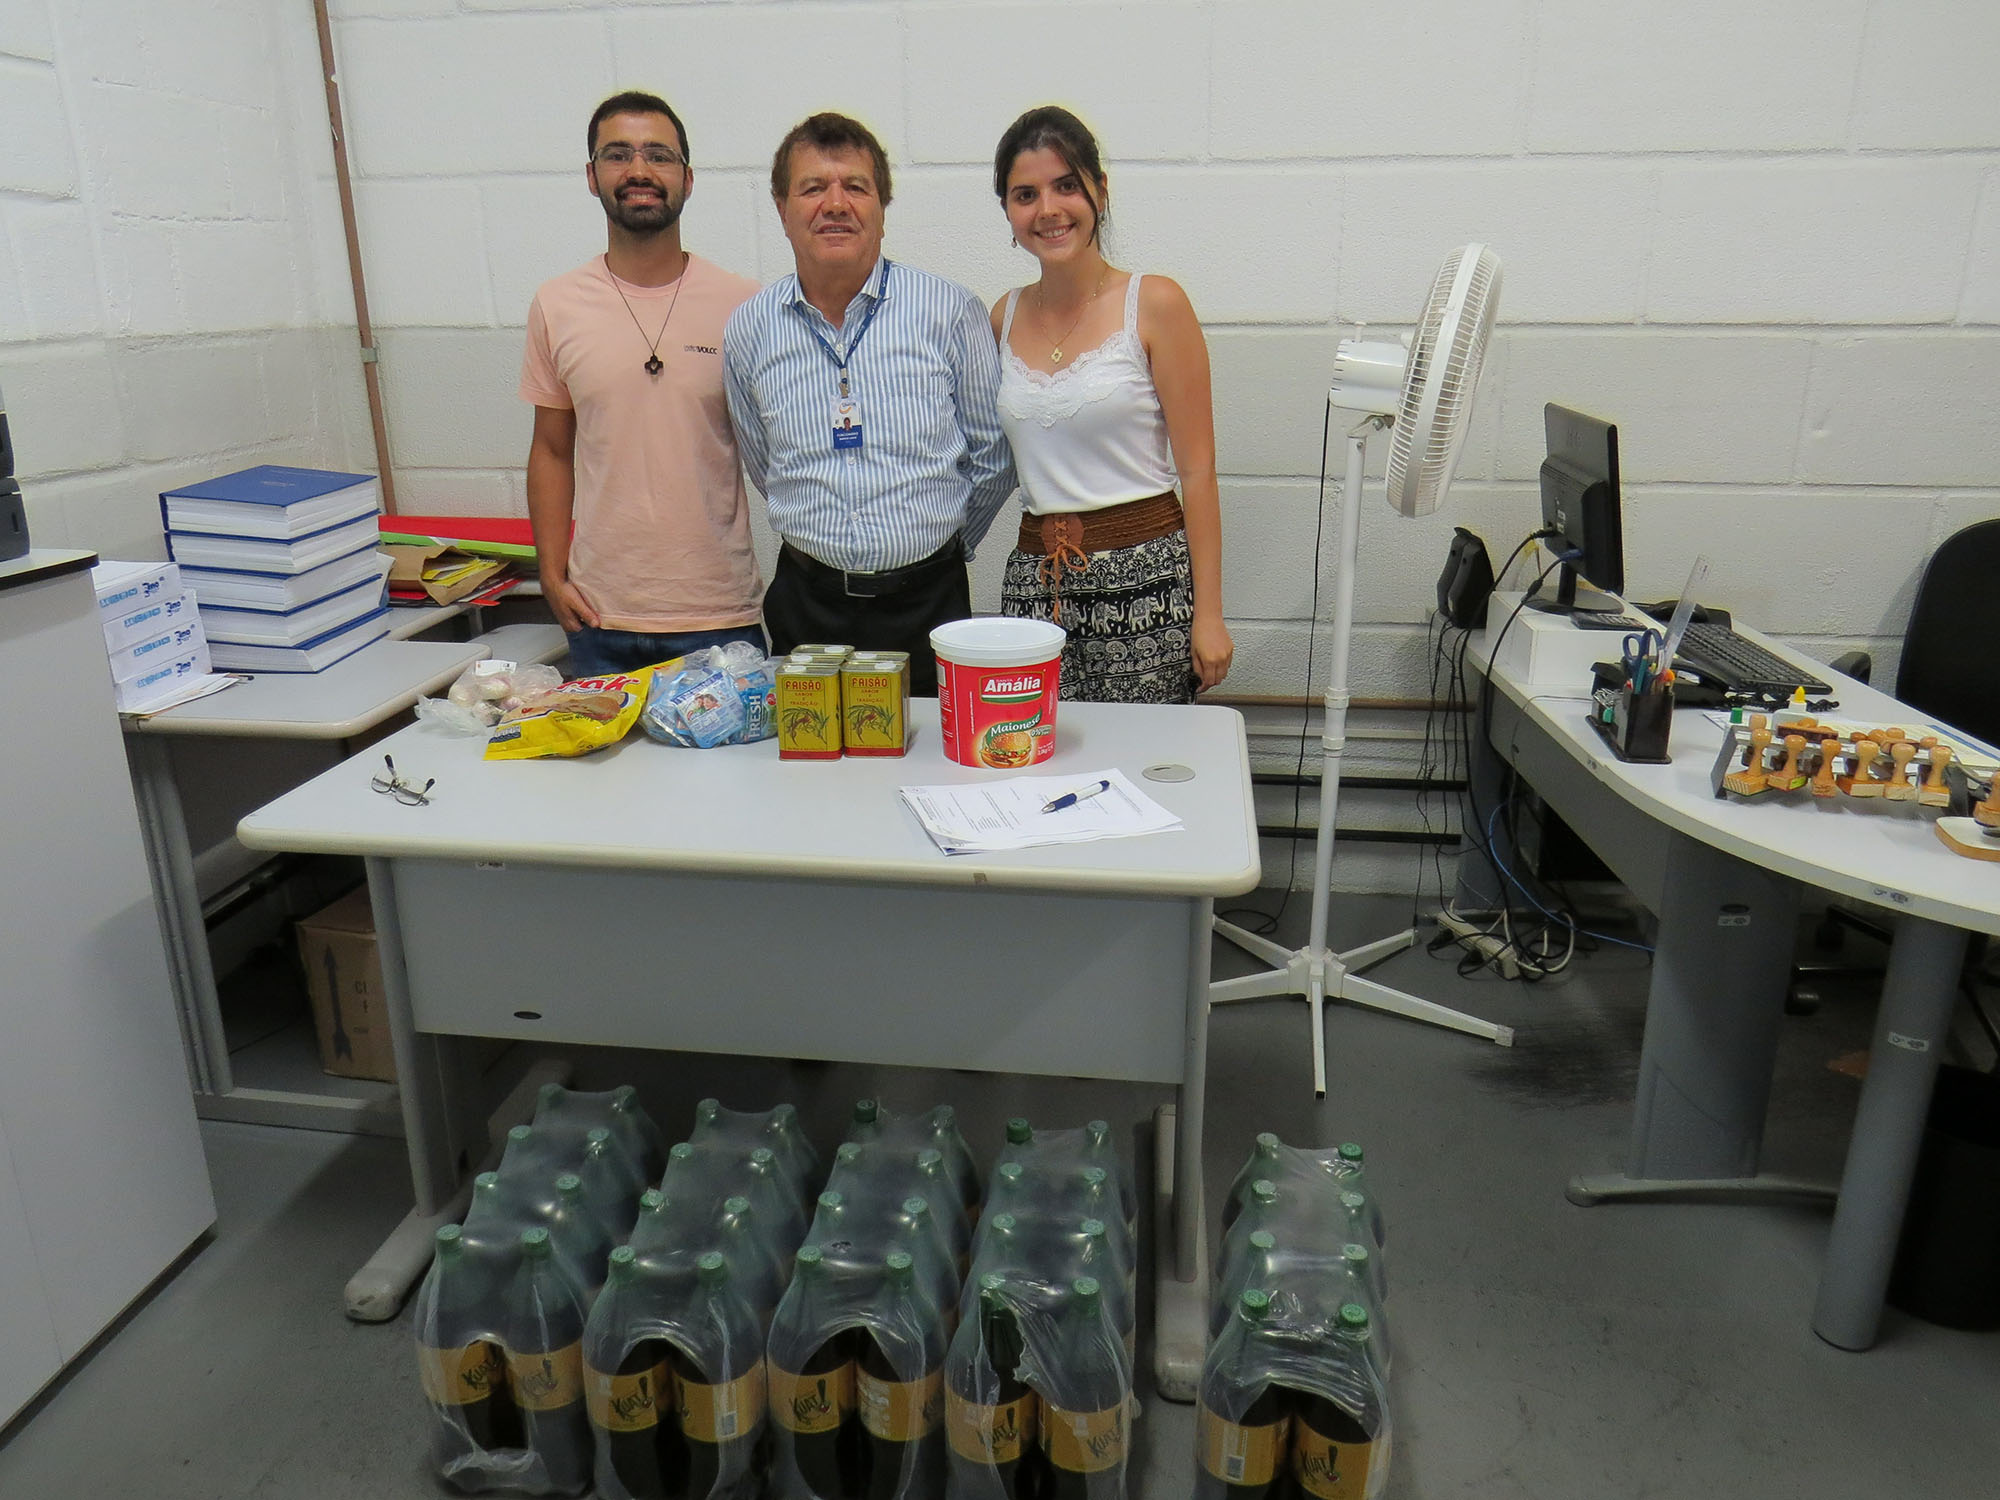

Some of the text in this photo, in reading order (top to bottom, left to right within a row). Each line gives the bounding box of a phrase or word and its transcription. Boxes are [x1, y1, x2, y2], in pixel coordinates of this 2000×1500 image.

[984, 676, 1041, 693] Amália
[749, 695, 761, 737] FRESH
[990, 714, 1040, 737] Maionese
